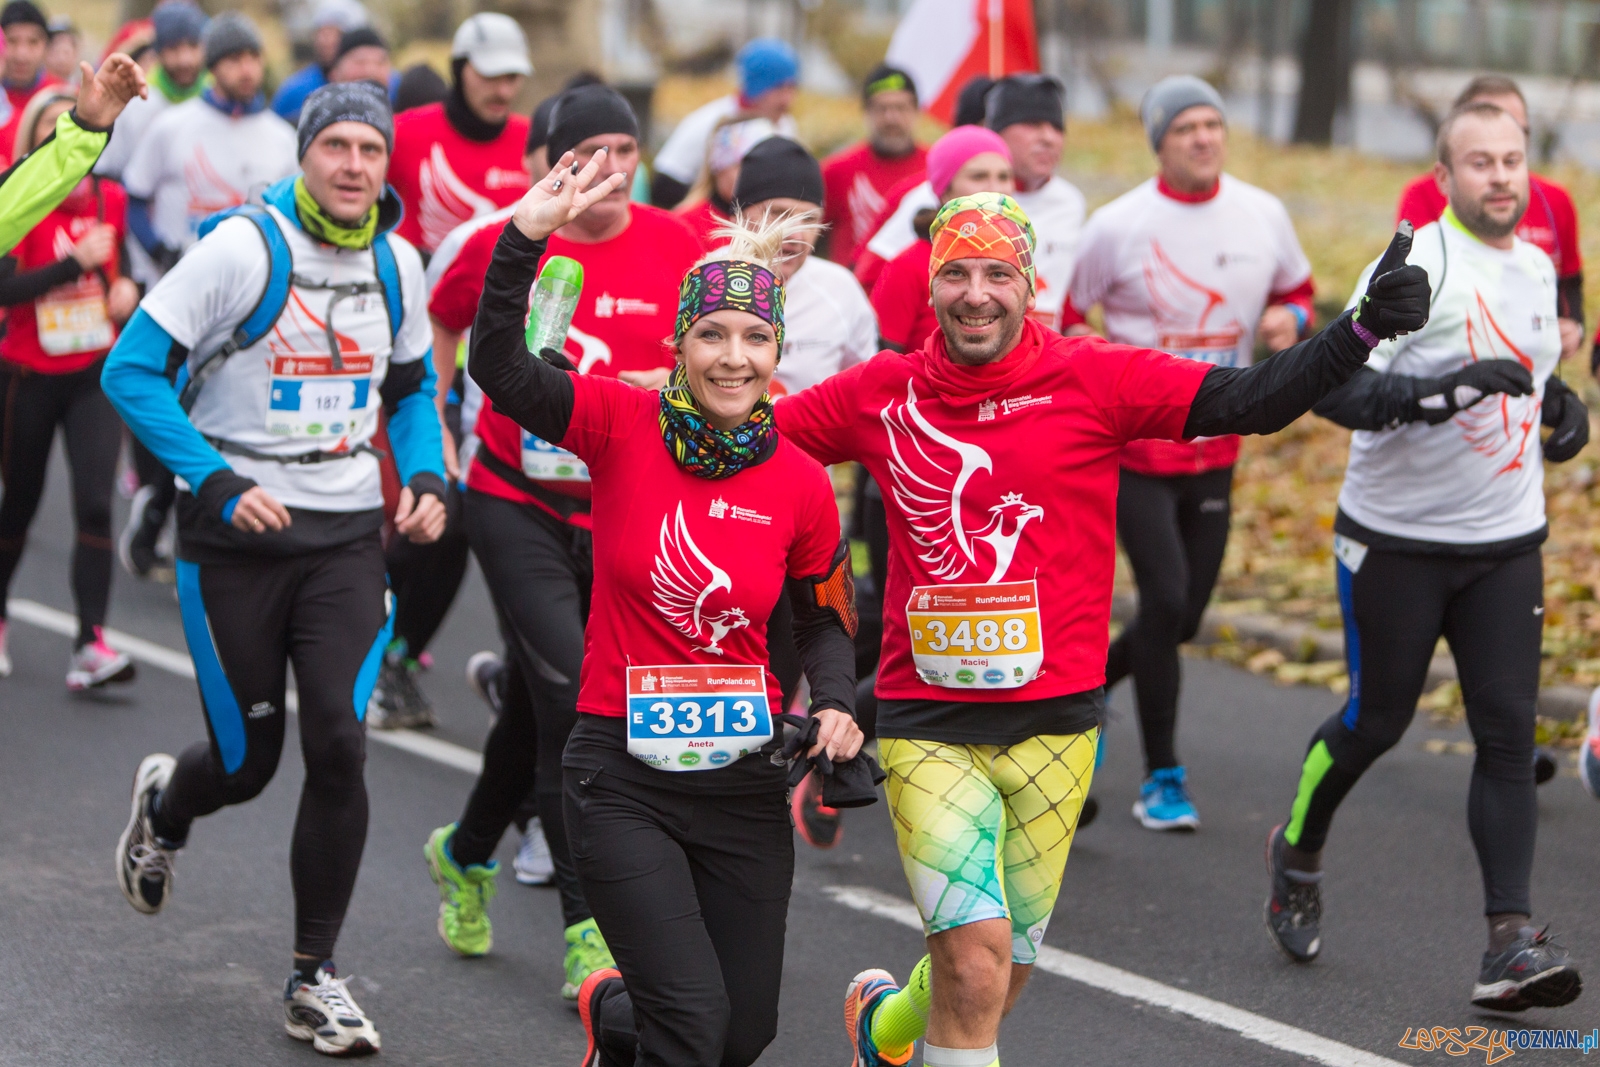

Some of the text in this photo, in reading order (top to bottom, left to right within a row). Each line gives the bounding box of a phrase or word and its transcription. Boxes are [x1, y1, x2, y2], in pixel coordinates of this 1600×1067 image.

[316, 396, 340, 411] 187
[1001, 399, 1011, 415] 1
[730, 505, 737, 518] 1
[975, 594, 1030, 604] RunPoland.org
[914, 618, 1028, 652] D 3488
[961, 658, 989, 667] Maciej
[660, 676, 666, 687] 1
[707, 677, 756, 687] RunPoland.org
[633, 700, 757, 734] E 3313
[687, 740, 714, 748] Aneta
